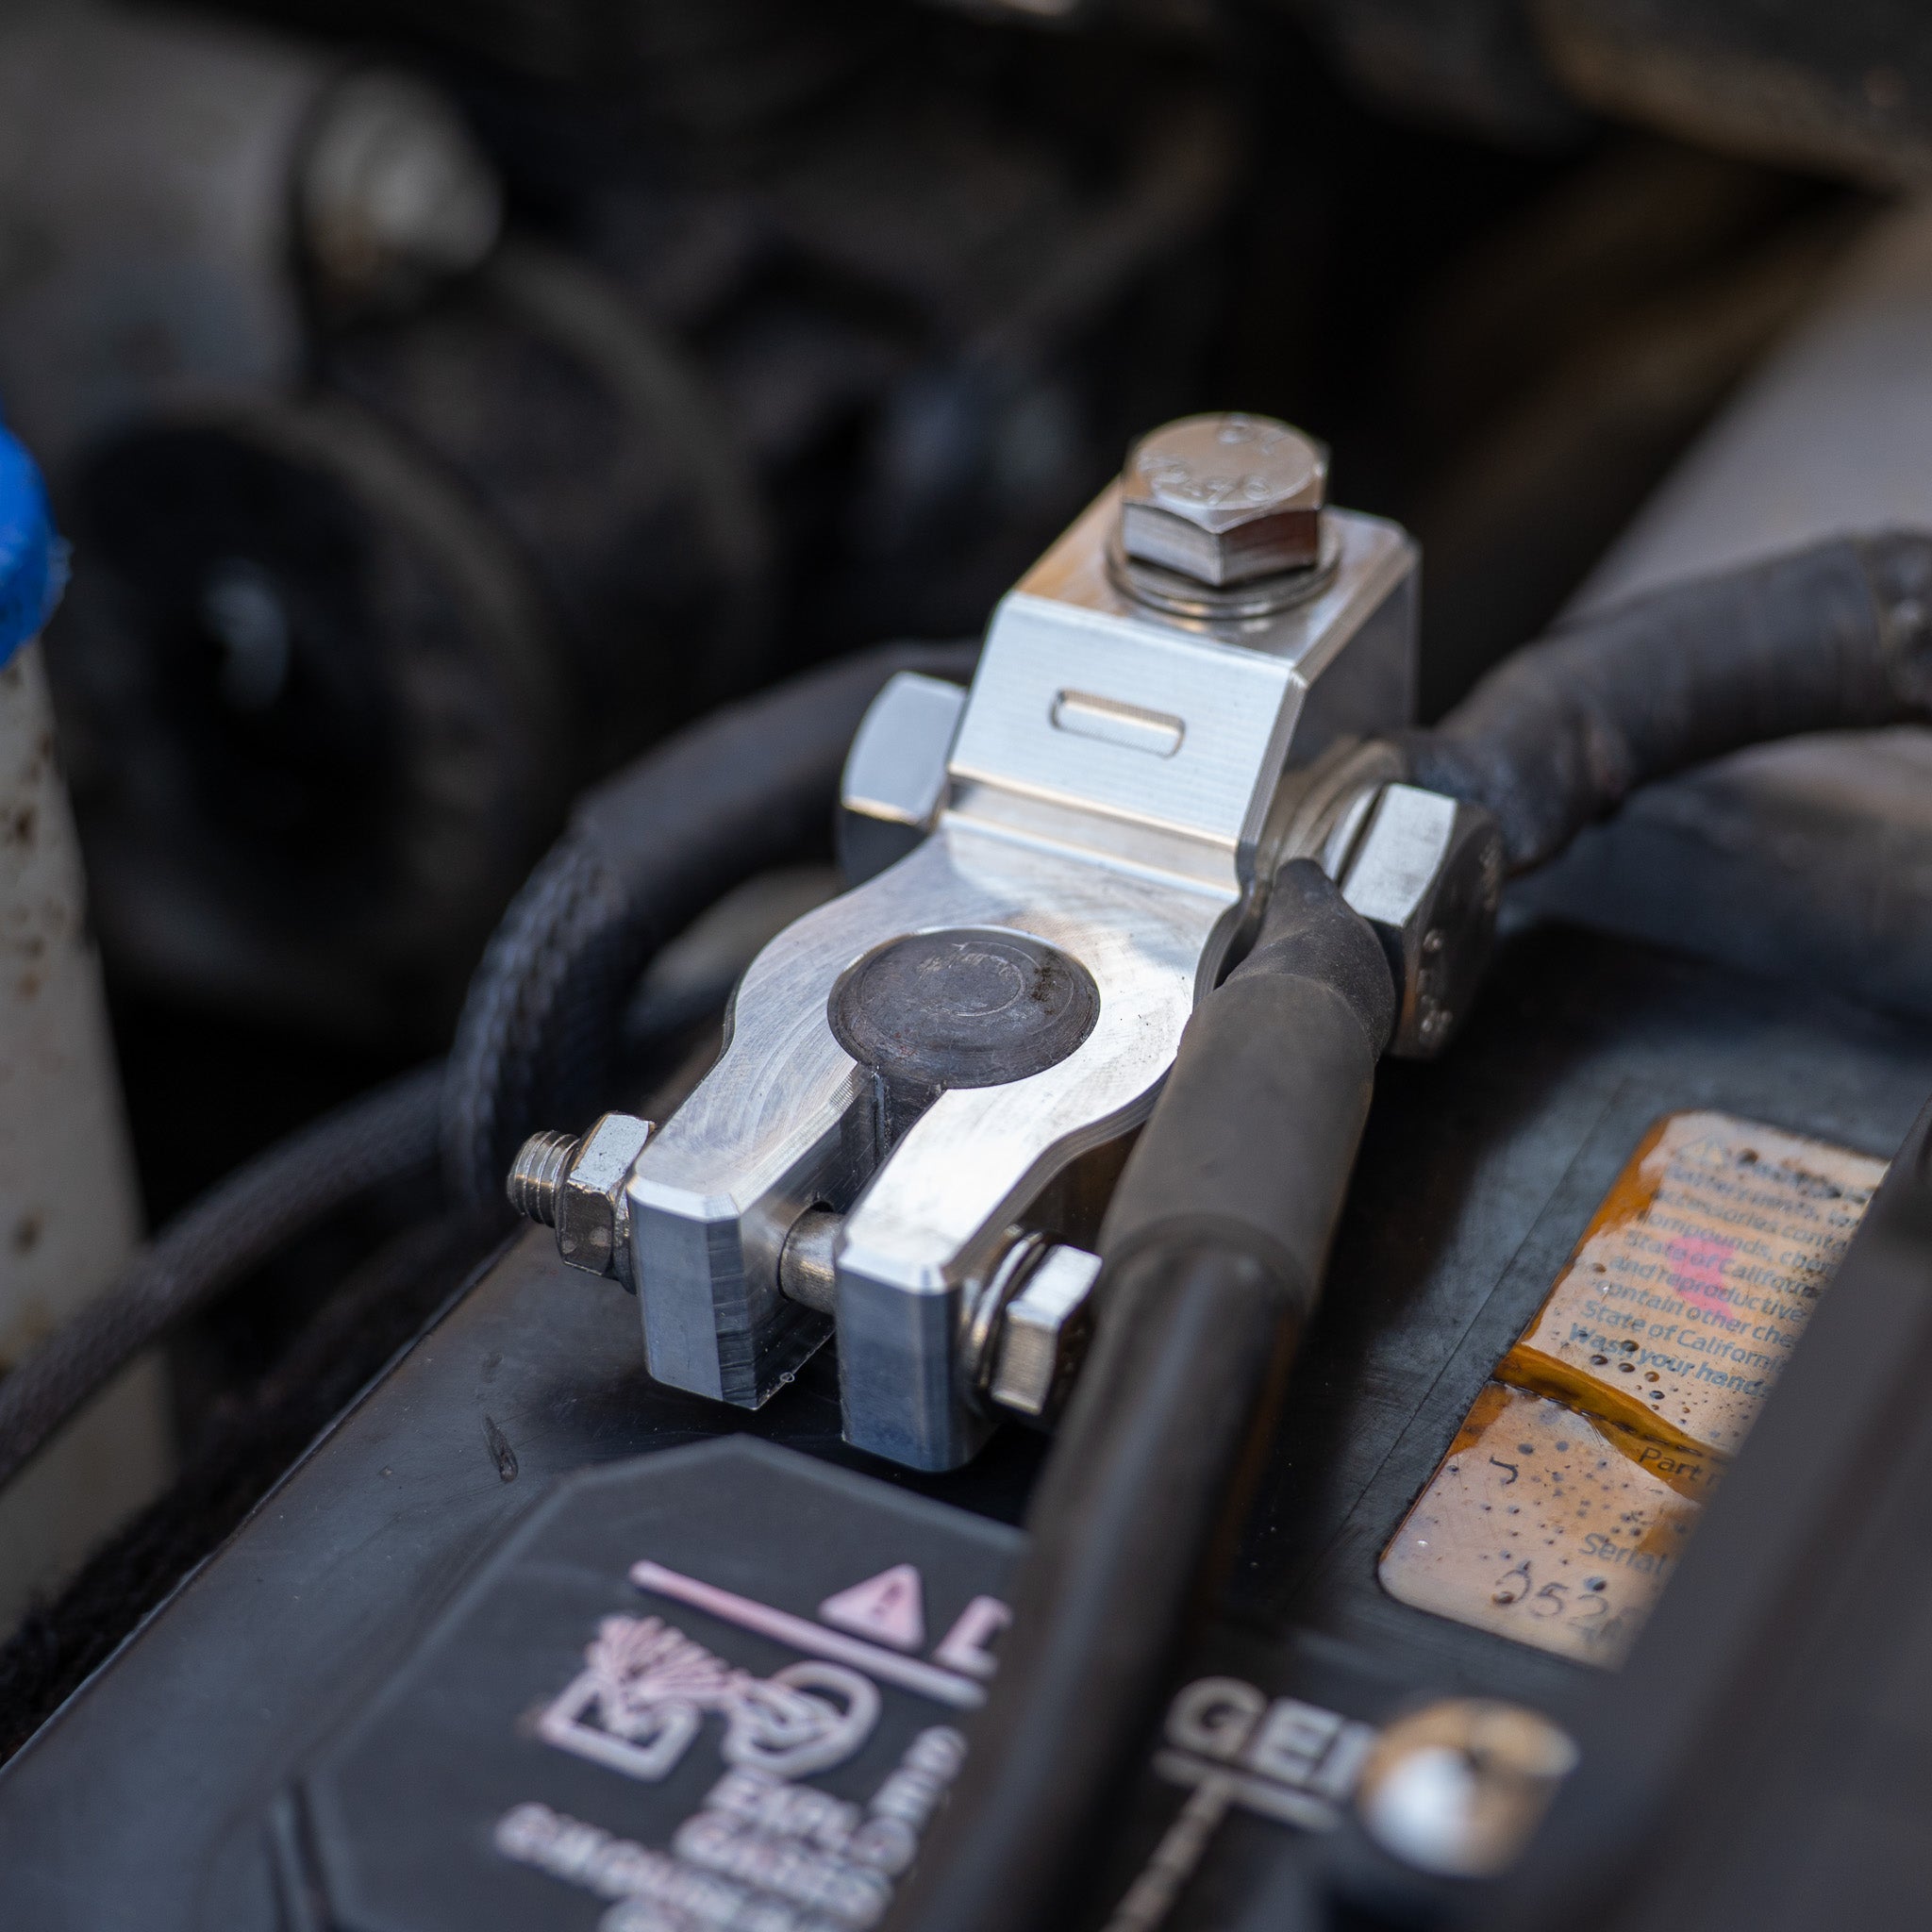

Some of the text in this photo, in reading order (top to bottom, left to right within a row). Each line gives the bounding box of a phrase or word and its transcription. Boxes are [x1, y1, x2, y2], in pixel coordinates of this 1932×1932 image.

[1653, 1189, 1777, 1233] ccessories
[1594, 1278, 1684, 1315] contain
[1686, 1305, 1752, 1336] other
[1609, 1256, 1807, 1322] and reproductive
[1569, 1323, 1635, 1358] Wash
[1635, 1346, 1695, 1377] your
[1580, 1299, 1788, 1370] State of Californi
[1639, 1444, 1703, 1482] Part
[1577, 1532, 1668, 1574] Serial
